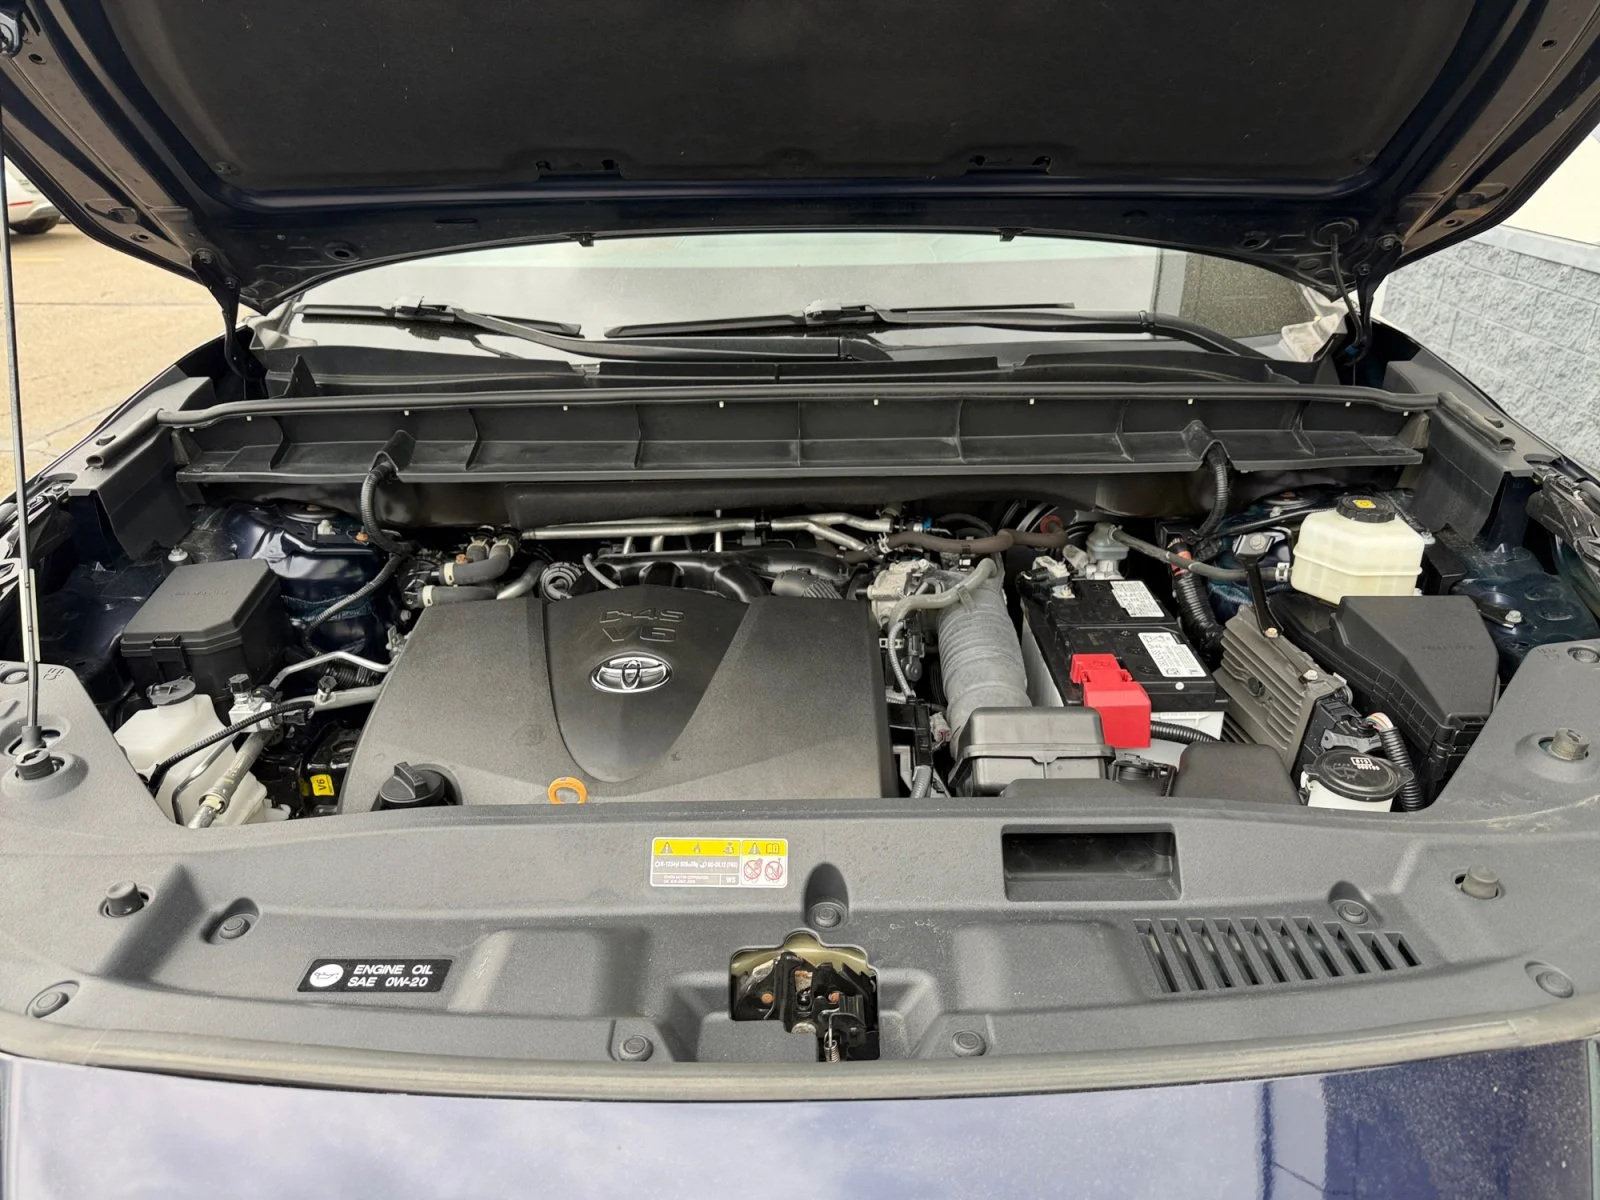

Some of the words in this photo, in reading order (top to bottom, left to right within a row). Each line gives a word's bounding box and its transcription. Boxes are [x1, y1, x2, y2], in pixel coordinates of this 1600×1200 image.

[600, 607, 685, 623] D-4S
[601, 626, 678, 642] V6
[316, 779, 327, 790] V6
[353, 964, 405, 975] ENGINE
[411, 965, 434, 975] OIL
[347, 976, 376, 987] SAE
[385, 976, 429, 987] 0W-20
